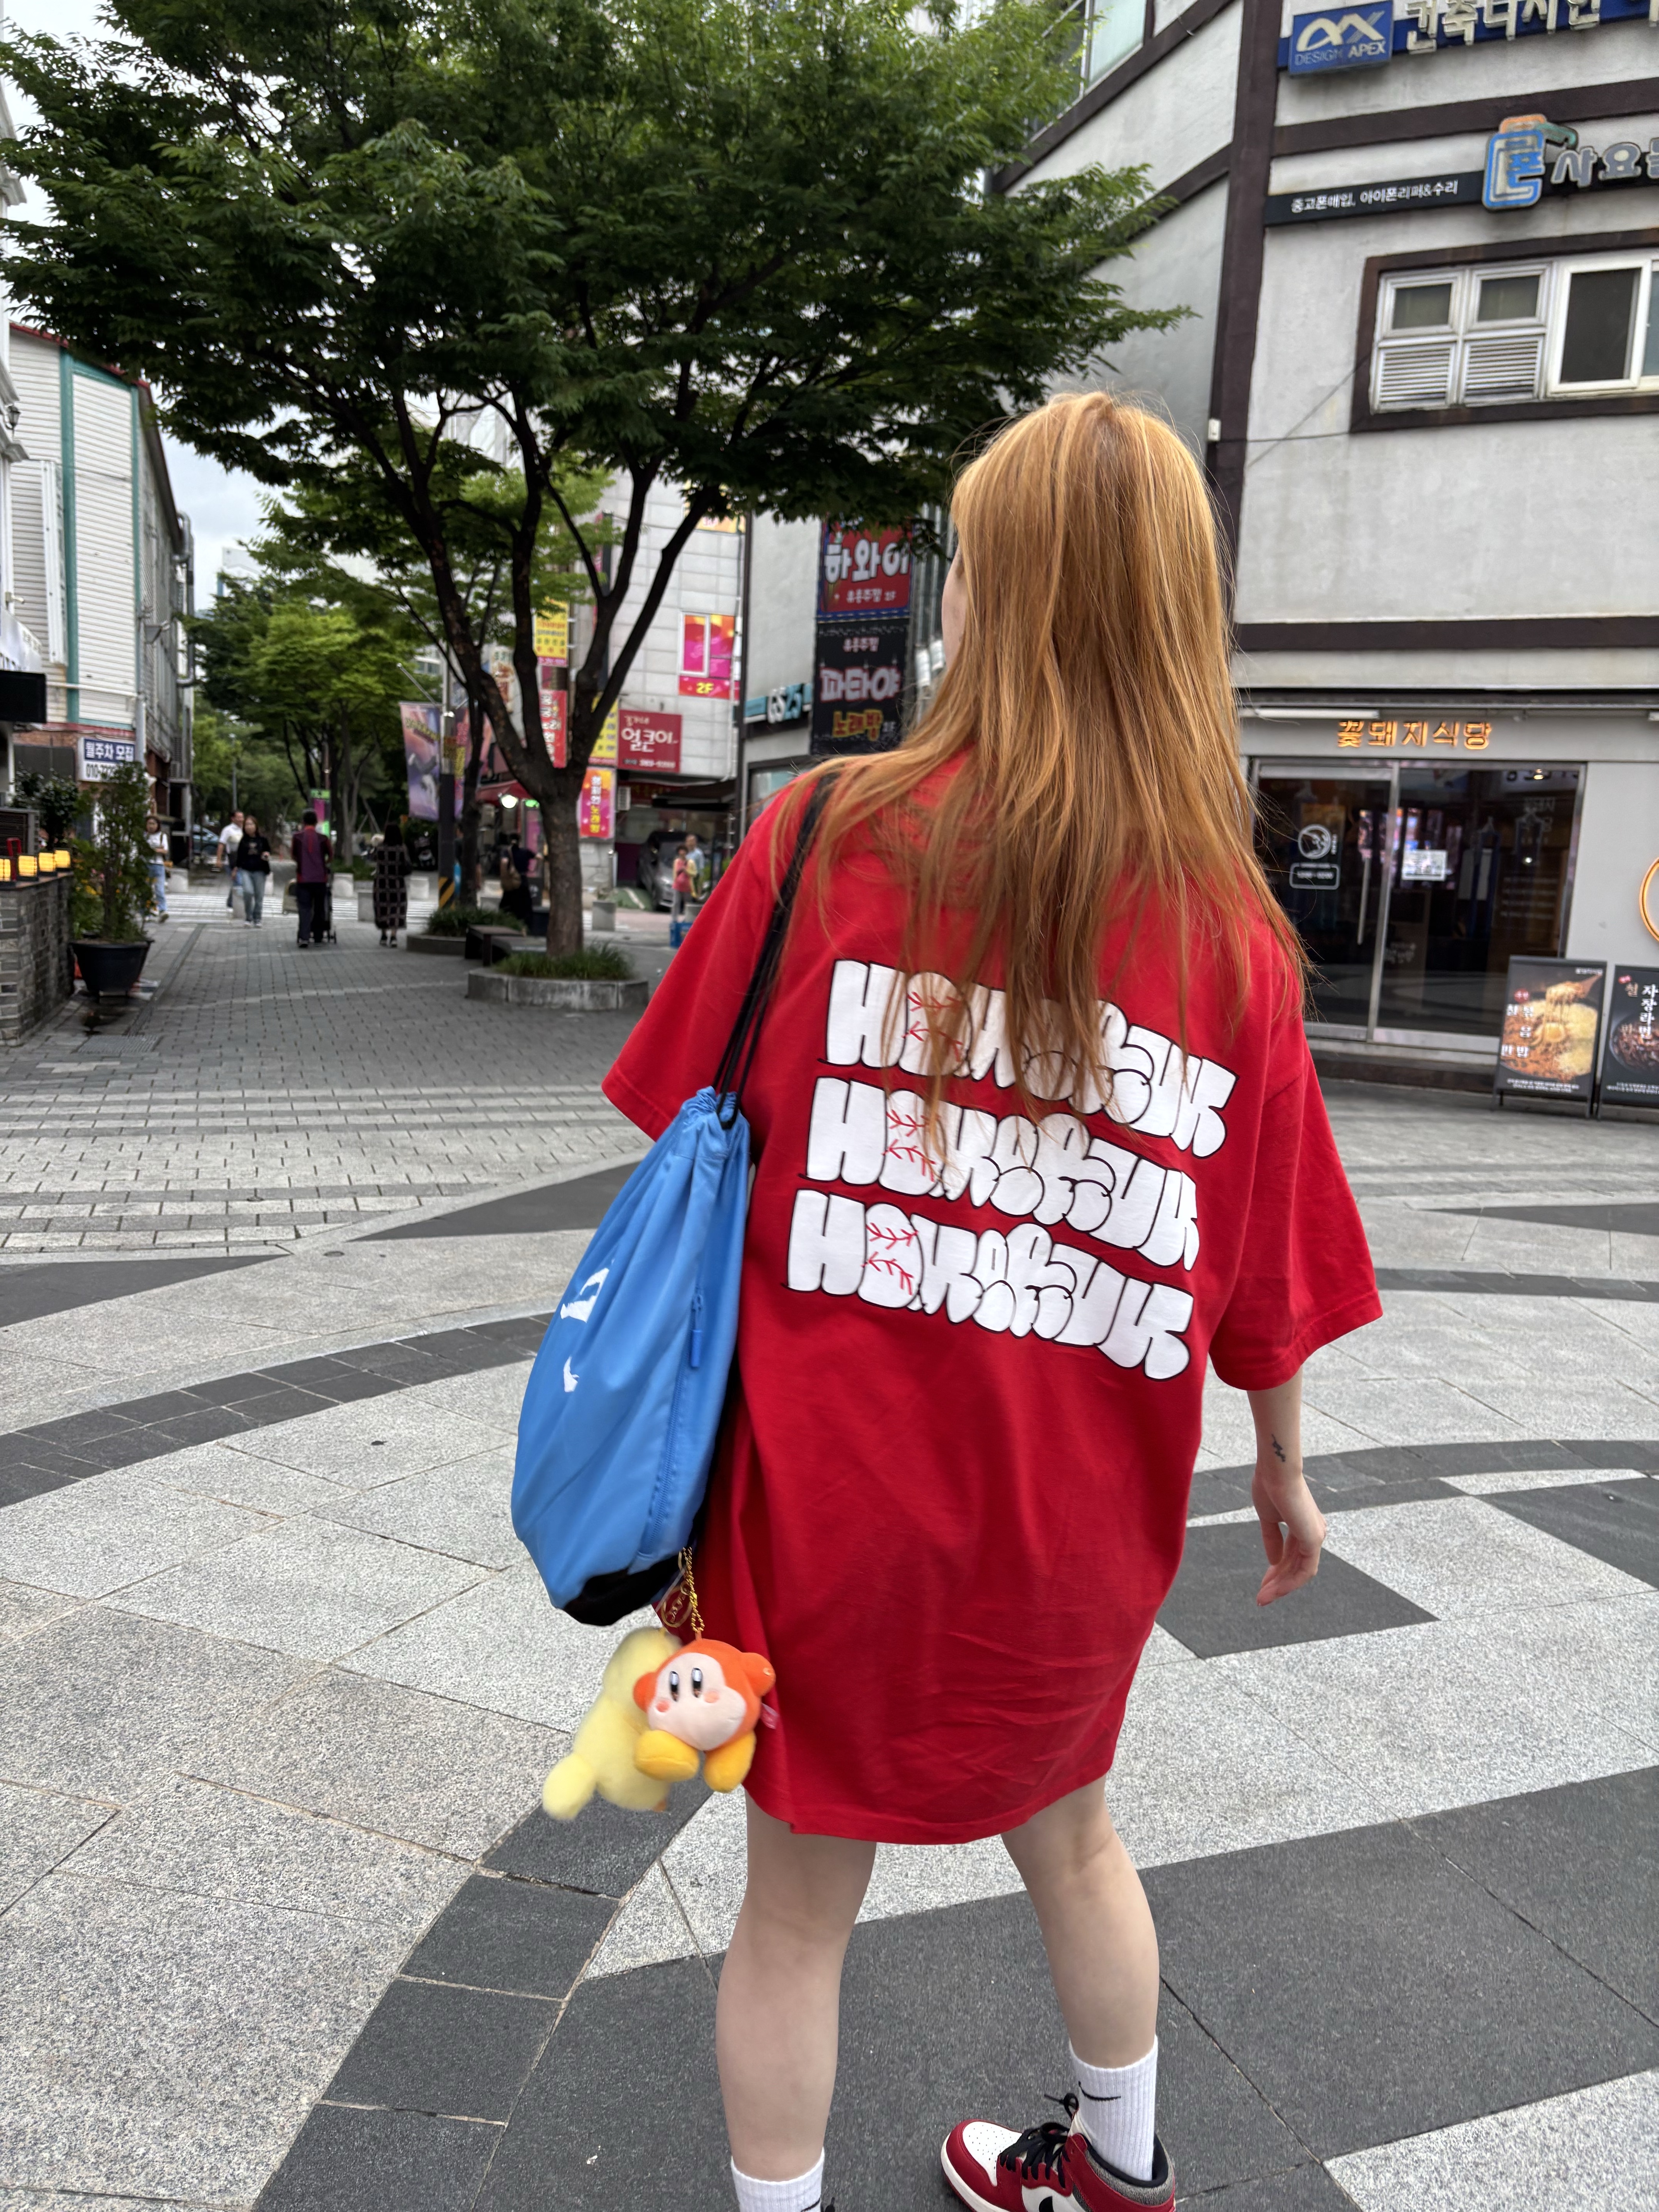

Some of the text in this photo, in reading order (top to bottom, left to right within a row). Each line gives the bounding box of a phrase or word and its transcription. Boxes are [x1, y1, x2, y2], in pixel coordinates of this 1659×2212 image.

[1295, 40, 1386, 65] DESIGN APEX
[824, 538, 910, 584] 하와이
[696, 682, 713, 694] 2F
[819, 666, 901, 702] 파타야
[833, 709, 884, 741] 노래방
[1338, 720, 1492, 750] 꽃돼지식당
